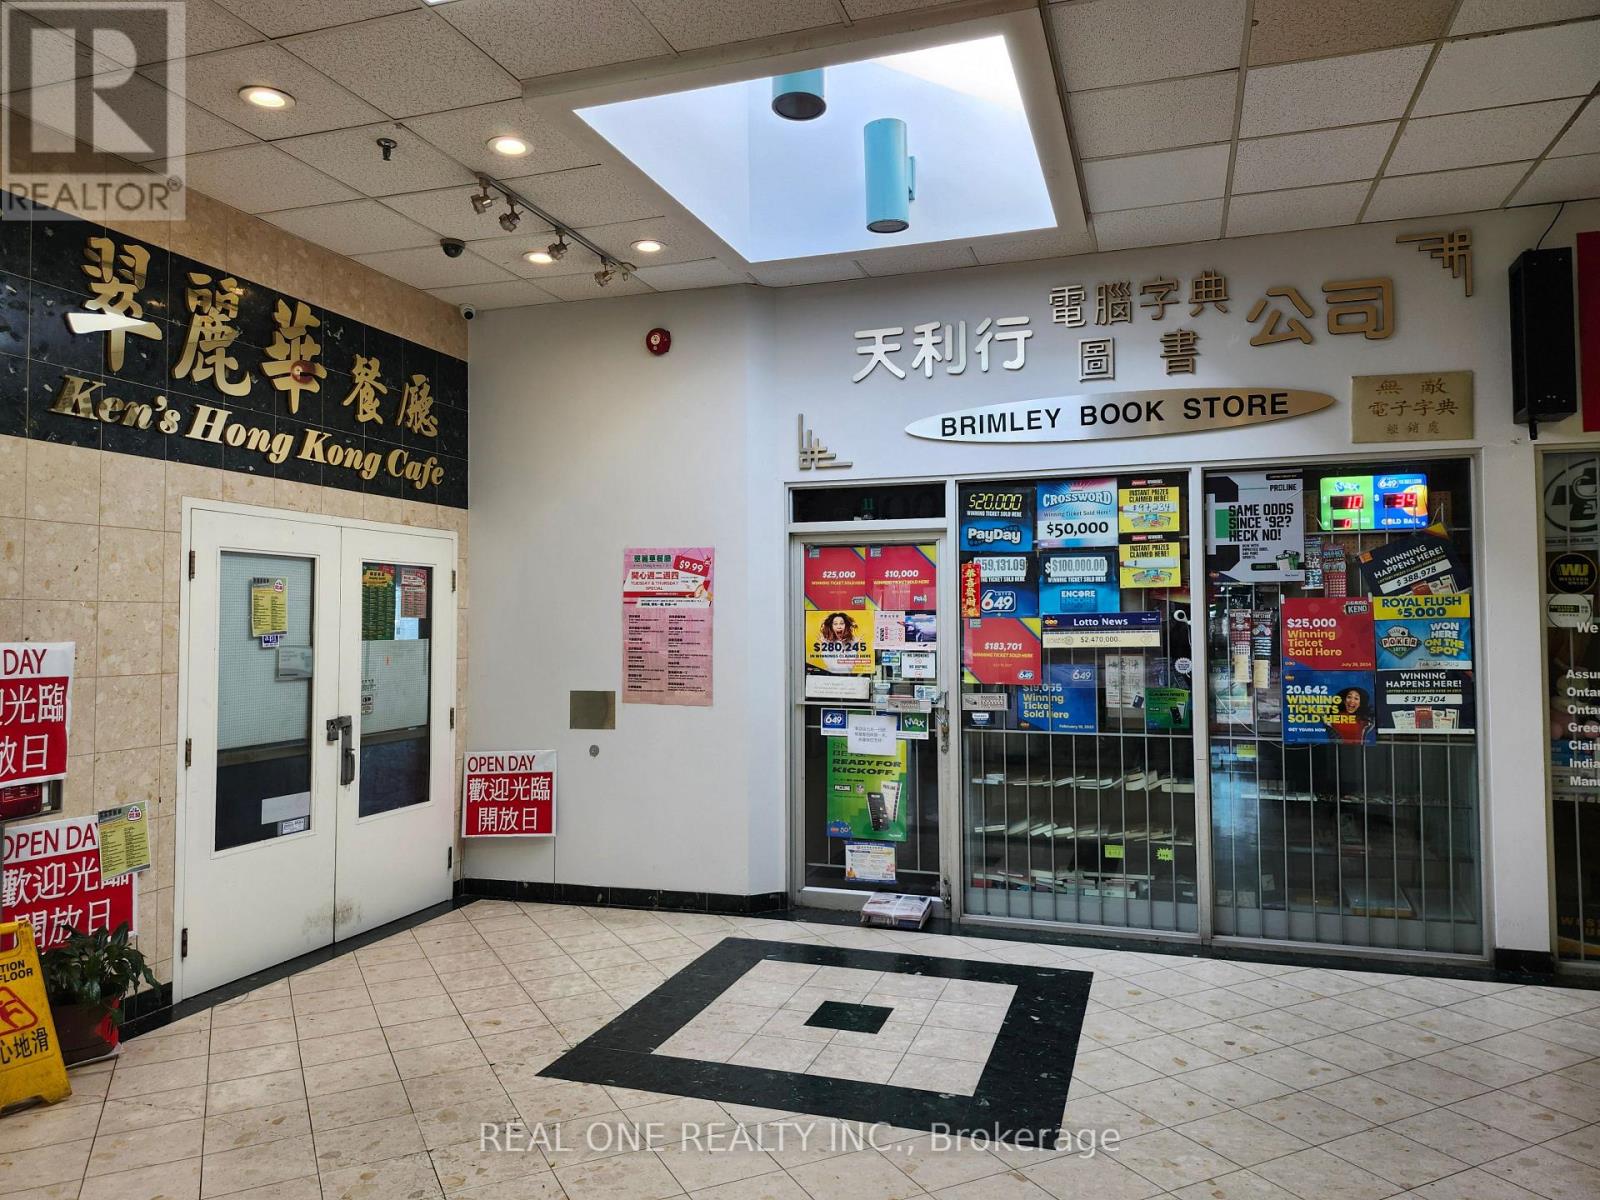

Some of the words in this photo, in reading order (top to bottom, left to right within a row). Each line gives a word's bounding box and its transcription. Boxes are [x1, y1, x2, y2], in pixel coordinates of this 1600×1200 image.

[1049, 269, 1230, 328] 電腦字典
[1246, 276, 1396, 347] 公司
[852, 315, 1033, 383] 天利行
[1368, 398, 1459, 417] 電子字典
[941, 408, 1061, 437] BRIMLEY
[1080, 400, 1164, 426] BOOK
[1183, 392, 1289, 420] STORE
[47, 374, 181, 434] Ken's
[184, 404, 295, 464] Hong
[297, 428, 383, 481] Kong
[387, 448, 445, 491] Cafe
[1269, 483, 1297, 492] PROLINE
[1042, 491, 1112, 508] CROSSWORD
[1347, 495, 1363, 509] 10
[1395, 494, 1417, 508] 34
[1228, 504, 1260, 517] SAME
[1263, 503, 1294, 516] ODDS
[1228, 516, 1262, 530] SINCE
[1047, 521, 1109, 538] $50,000
[1229, 529, 1259, 542] HECK
[1262, 528, 1282, 541] NO!
[968, 527, 1021, 544] PayDay
[1383, 544, 1427, 566] WINNING
[679, 559, 704, 573] $9.99
[1373, 559, 1416, 579] HAPPENS
[1416, 545, 1444, 562] HERE!
[822, 570, 856, 579] $25,000
[884, 569, 919, 578] $10,000
[1061, 590, 1096, 598] ENCORE
[1382, 597, 1421, 608] ROYAL
[1424, 595, 1462, 606] FLUSH
[1347, 605, 1368, 613] KENO
[1074, 618, 1099, 626] Lotto
[1101, 618, 1129, 626] News
[1287, 618, 1337, 629] $25,000
[1430, 622, 1459, 631] WON
[1577, 621, 1598, 633] We
[1287, 629, 1336, 640] Winning
[1431, 630, 1459, 639] HERE
[813, 642, 867, 653] $280,245
[984, 642, 1023, 651] $183,701
[1287, 638, 1323, 647] Ticket
[1383, 638, 1417, 647] POKER
[1424, 639, 1442, 647] ON
[1445, 639, 1465, 650] THE
[1288, 648, 1313, 656] Sold
[1315, 648, 1342, 656] Here
[1430, 646, 1460, 656] SPOT
[3, 648, 48, 675] DAY
[1400, 672, 1446, 680] WINNING
[1385, 680, 1431, 688] HAPPENS
[1433, 679, 1462, 688] HERE!
[0, 682, 65, 726] 光臨
[1286, 694, 1342, 705] WINNING
[1411, 695, 1446, 703] 317,304
[1023, 710, 1044, 718] Sold
[1287, 705, 1339, 714] TICKETS
[1287, 714, 1321, 723] SOLD
[1323, 714, 1357, 724] HERE
[1568, 722, 1600, 733] Gree
[467, 755, 505, 772] OPEN
[508, 754, 536, 771] DAY
[468, 776, 551, 803] 歡迎光臨
[478, 806, 538, 832] 開放日
[66, 822, 98, 850] DA
